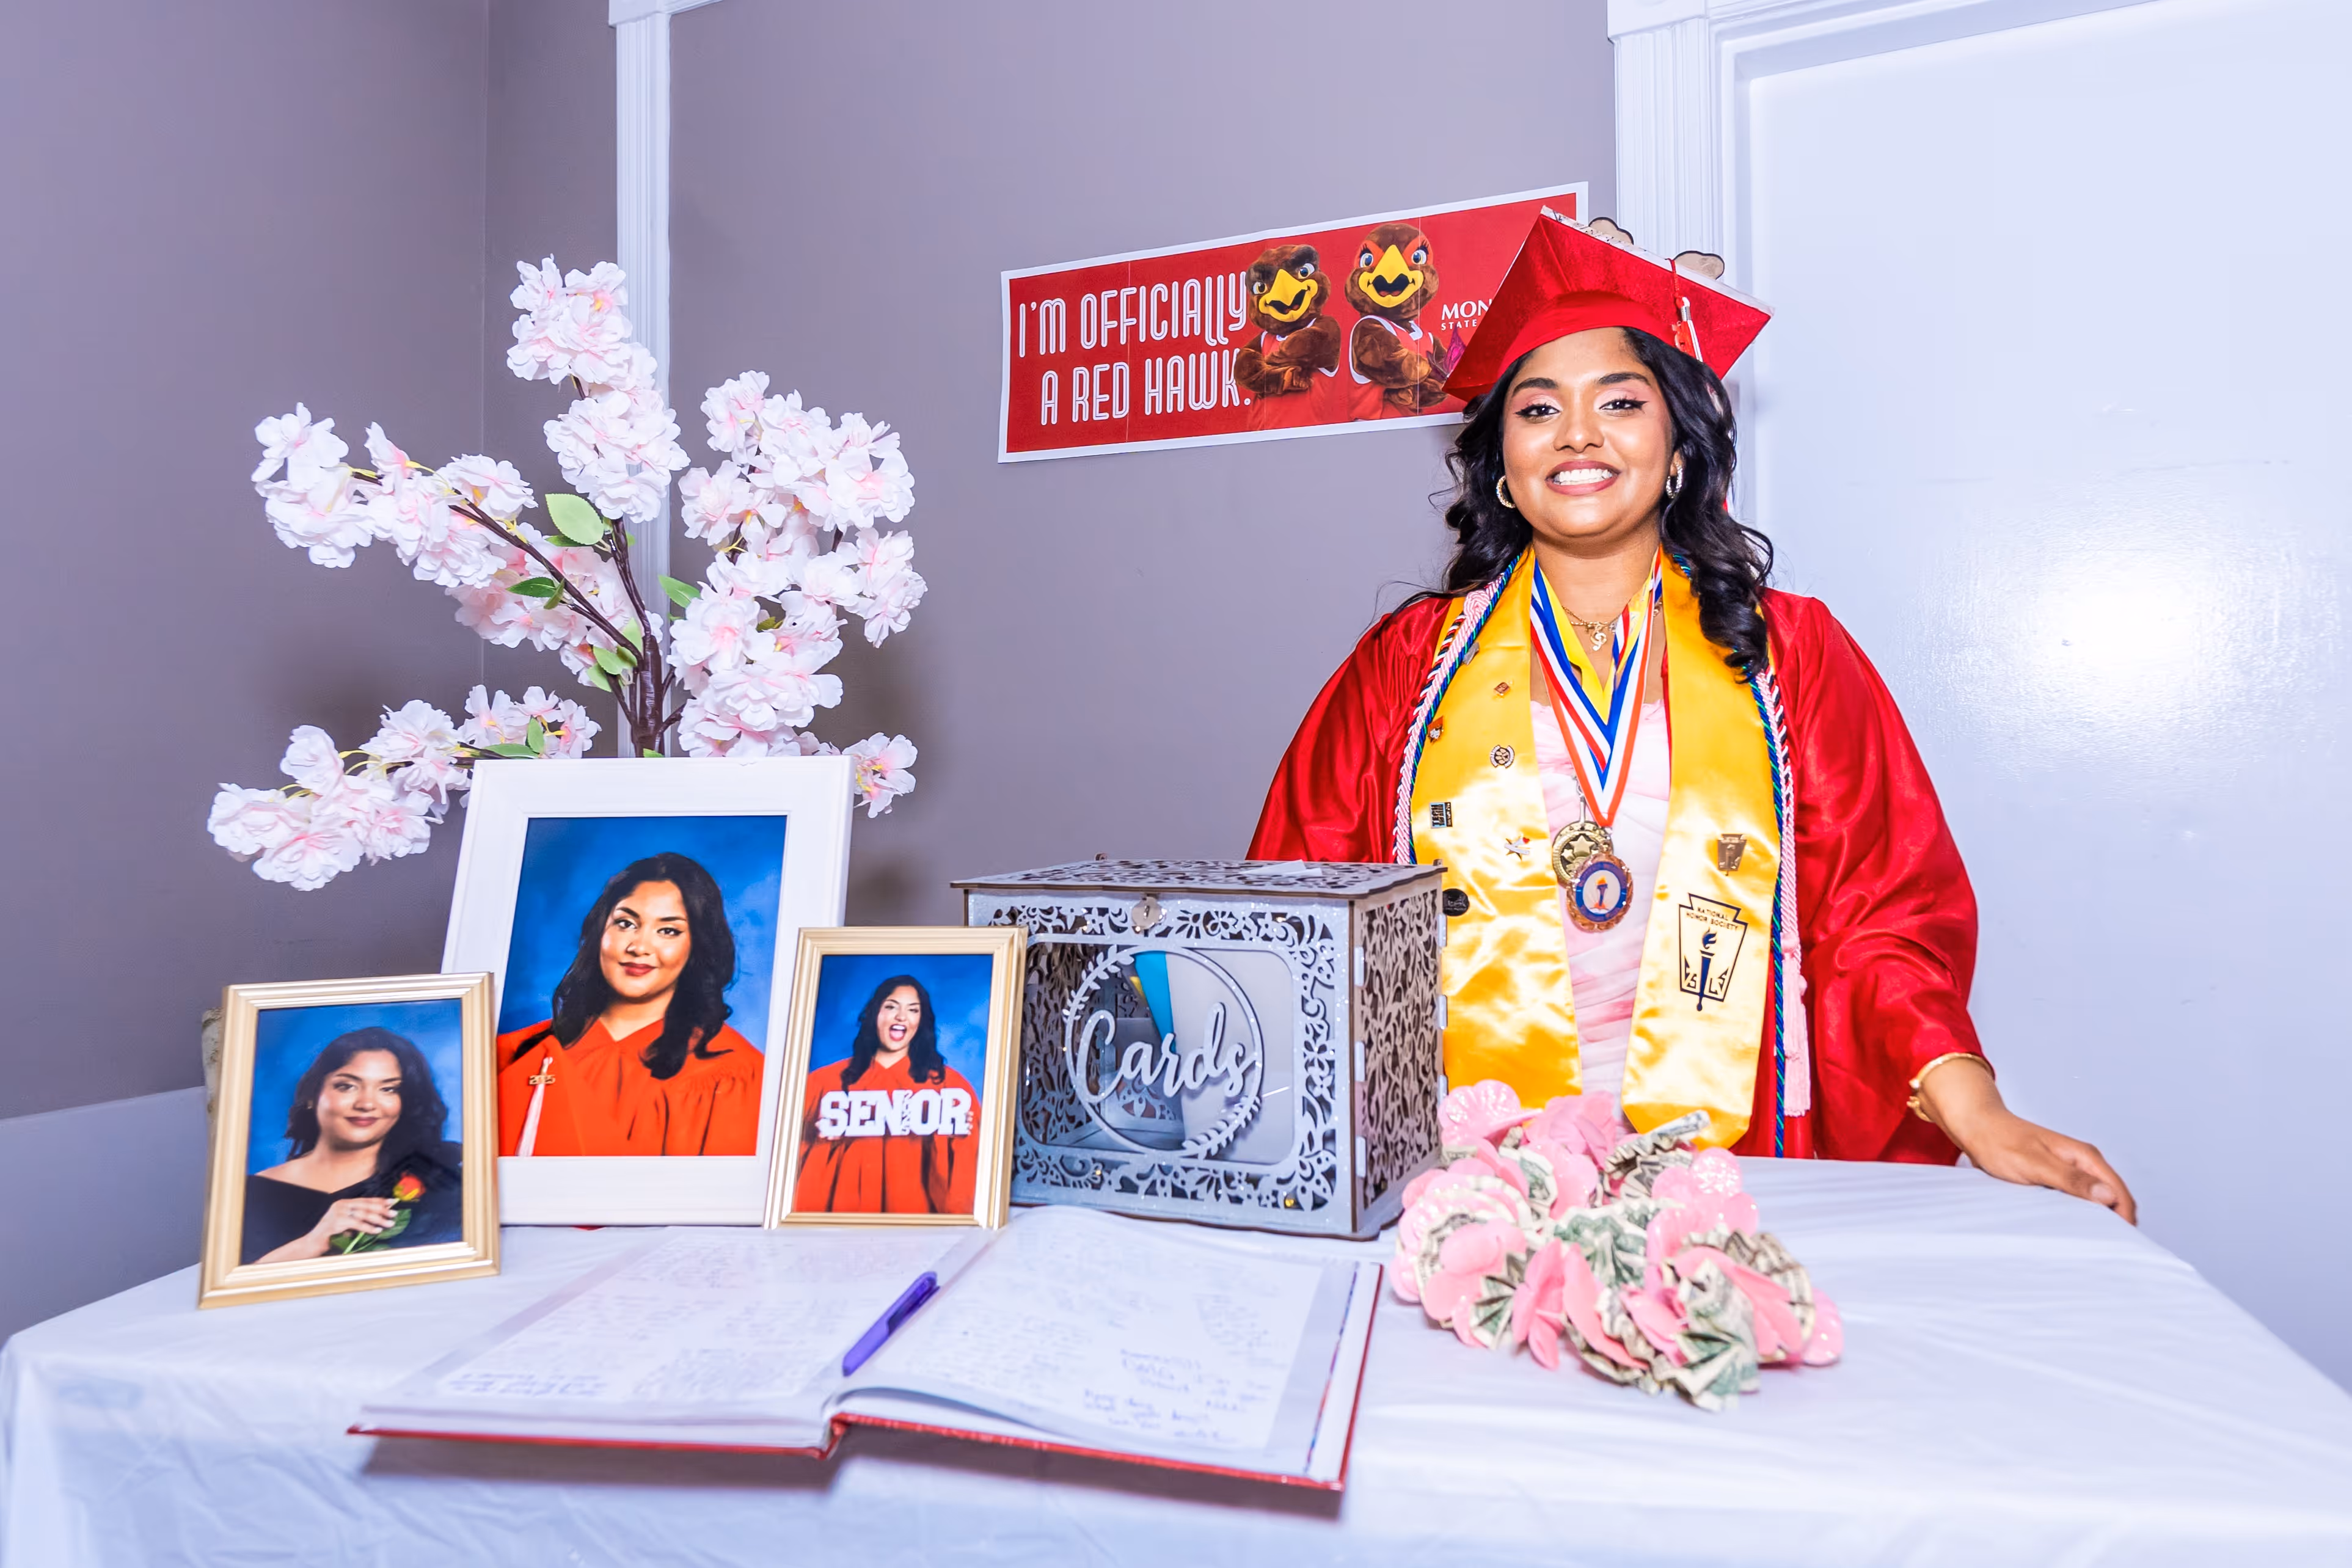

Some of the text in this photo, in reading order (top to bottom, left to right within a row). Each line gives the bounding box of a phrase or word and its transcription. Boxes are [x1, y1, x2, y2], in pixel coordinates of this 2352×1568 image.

[1018, 271, 1247, 358] I'M OFFICIALLY
[1441, 319, 1477, 330] STATE
[1040, 348, 1252, 426] A RED HAWK.
[1686, 912, 1739, 931] HONOR SOCIETY
[1697, 907, 1729, 921] NATIONAL
[1076, 1002, 1257, 1103] Cards
